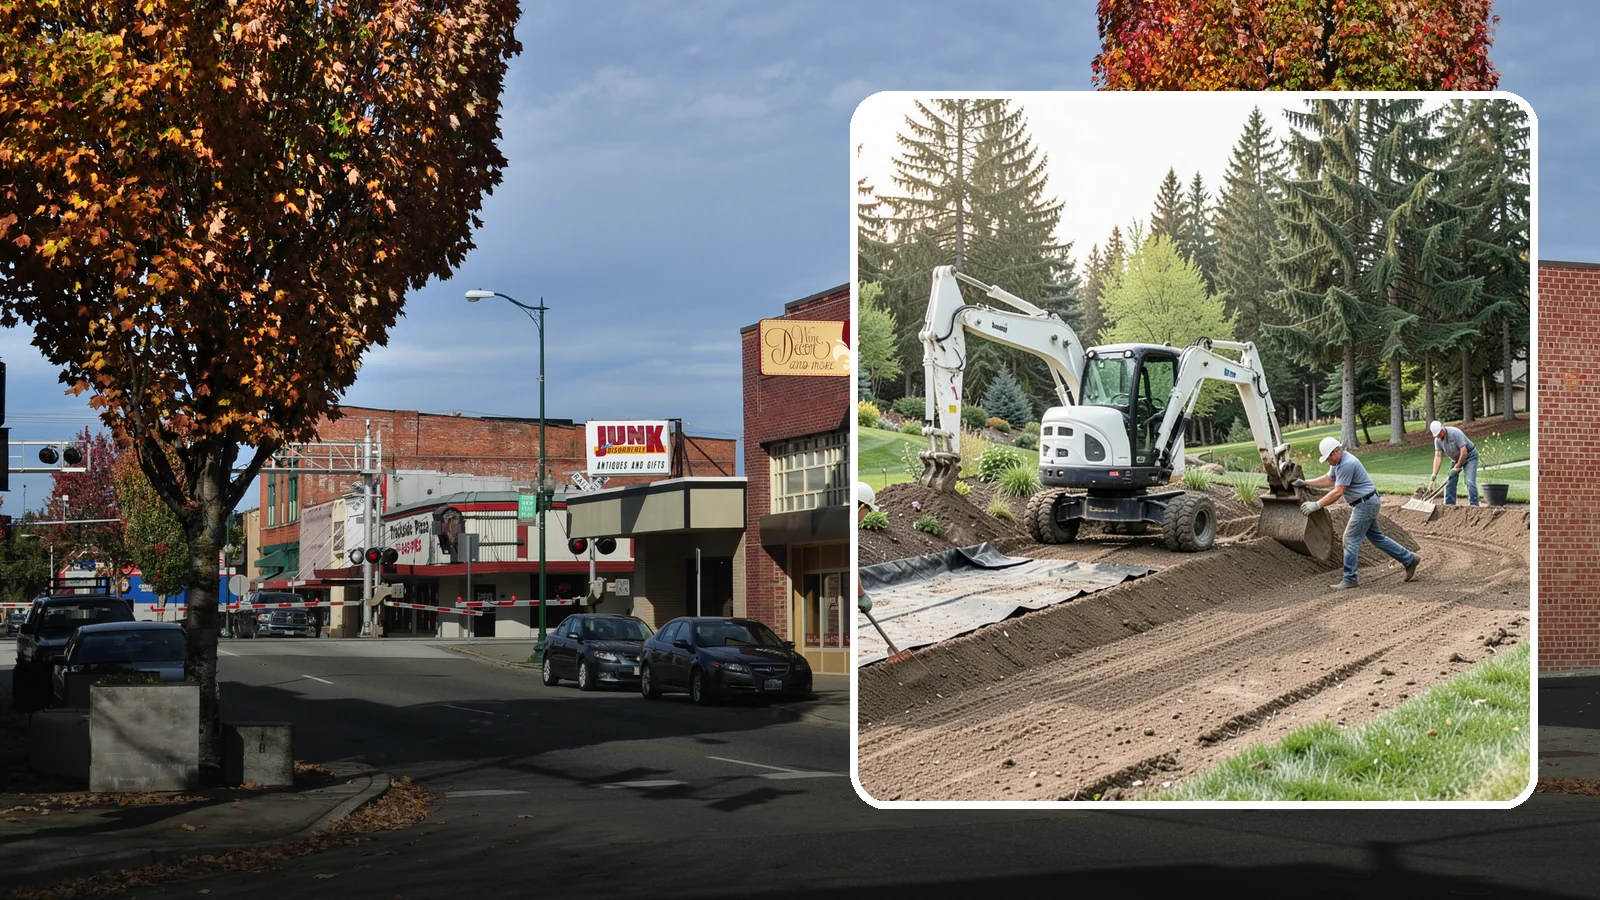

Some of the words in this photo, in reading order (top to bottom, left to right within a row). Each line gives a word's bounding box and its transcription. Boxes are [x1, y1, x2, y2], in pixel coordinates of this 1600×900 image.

[595, 425, 665, 457] JUNK
[607, 446, 646, 454] DISORDERLY
[597, 461, 628, 470] ANTIQUES
[631, 461, 644, 470] AND
[647, 460, 665, 470] GIFTS
[572, 473, 589, 491] RAIL
[390, 521, 413, 540] Trackside
[414, 519, 429, 535] Pizza
